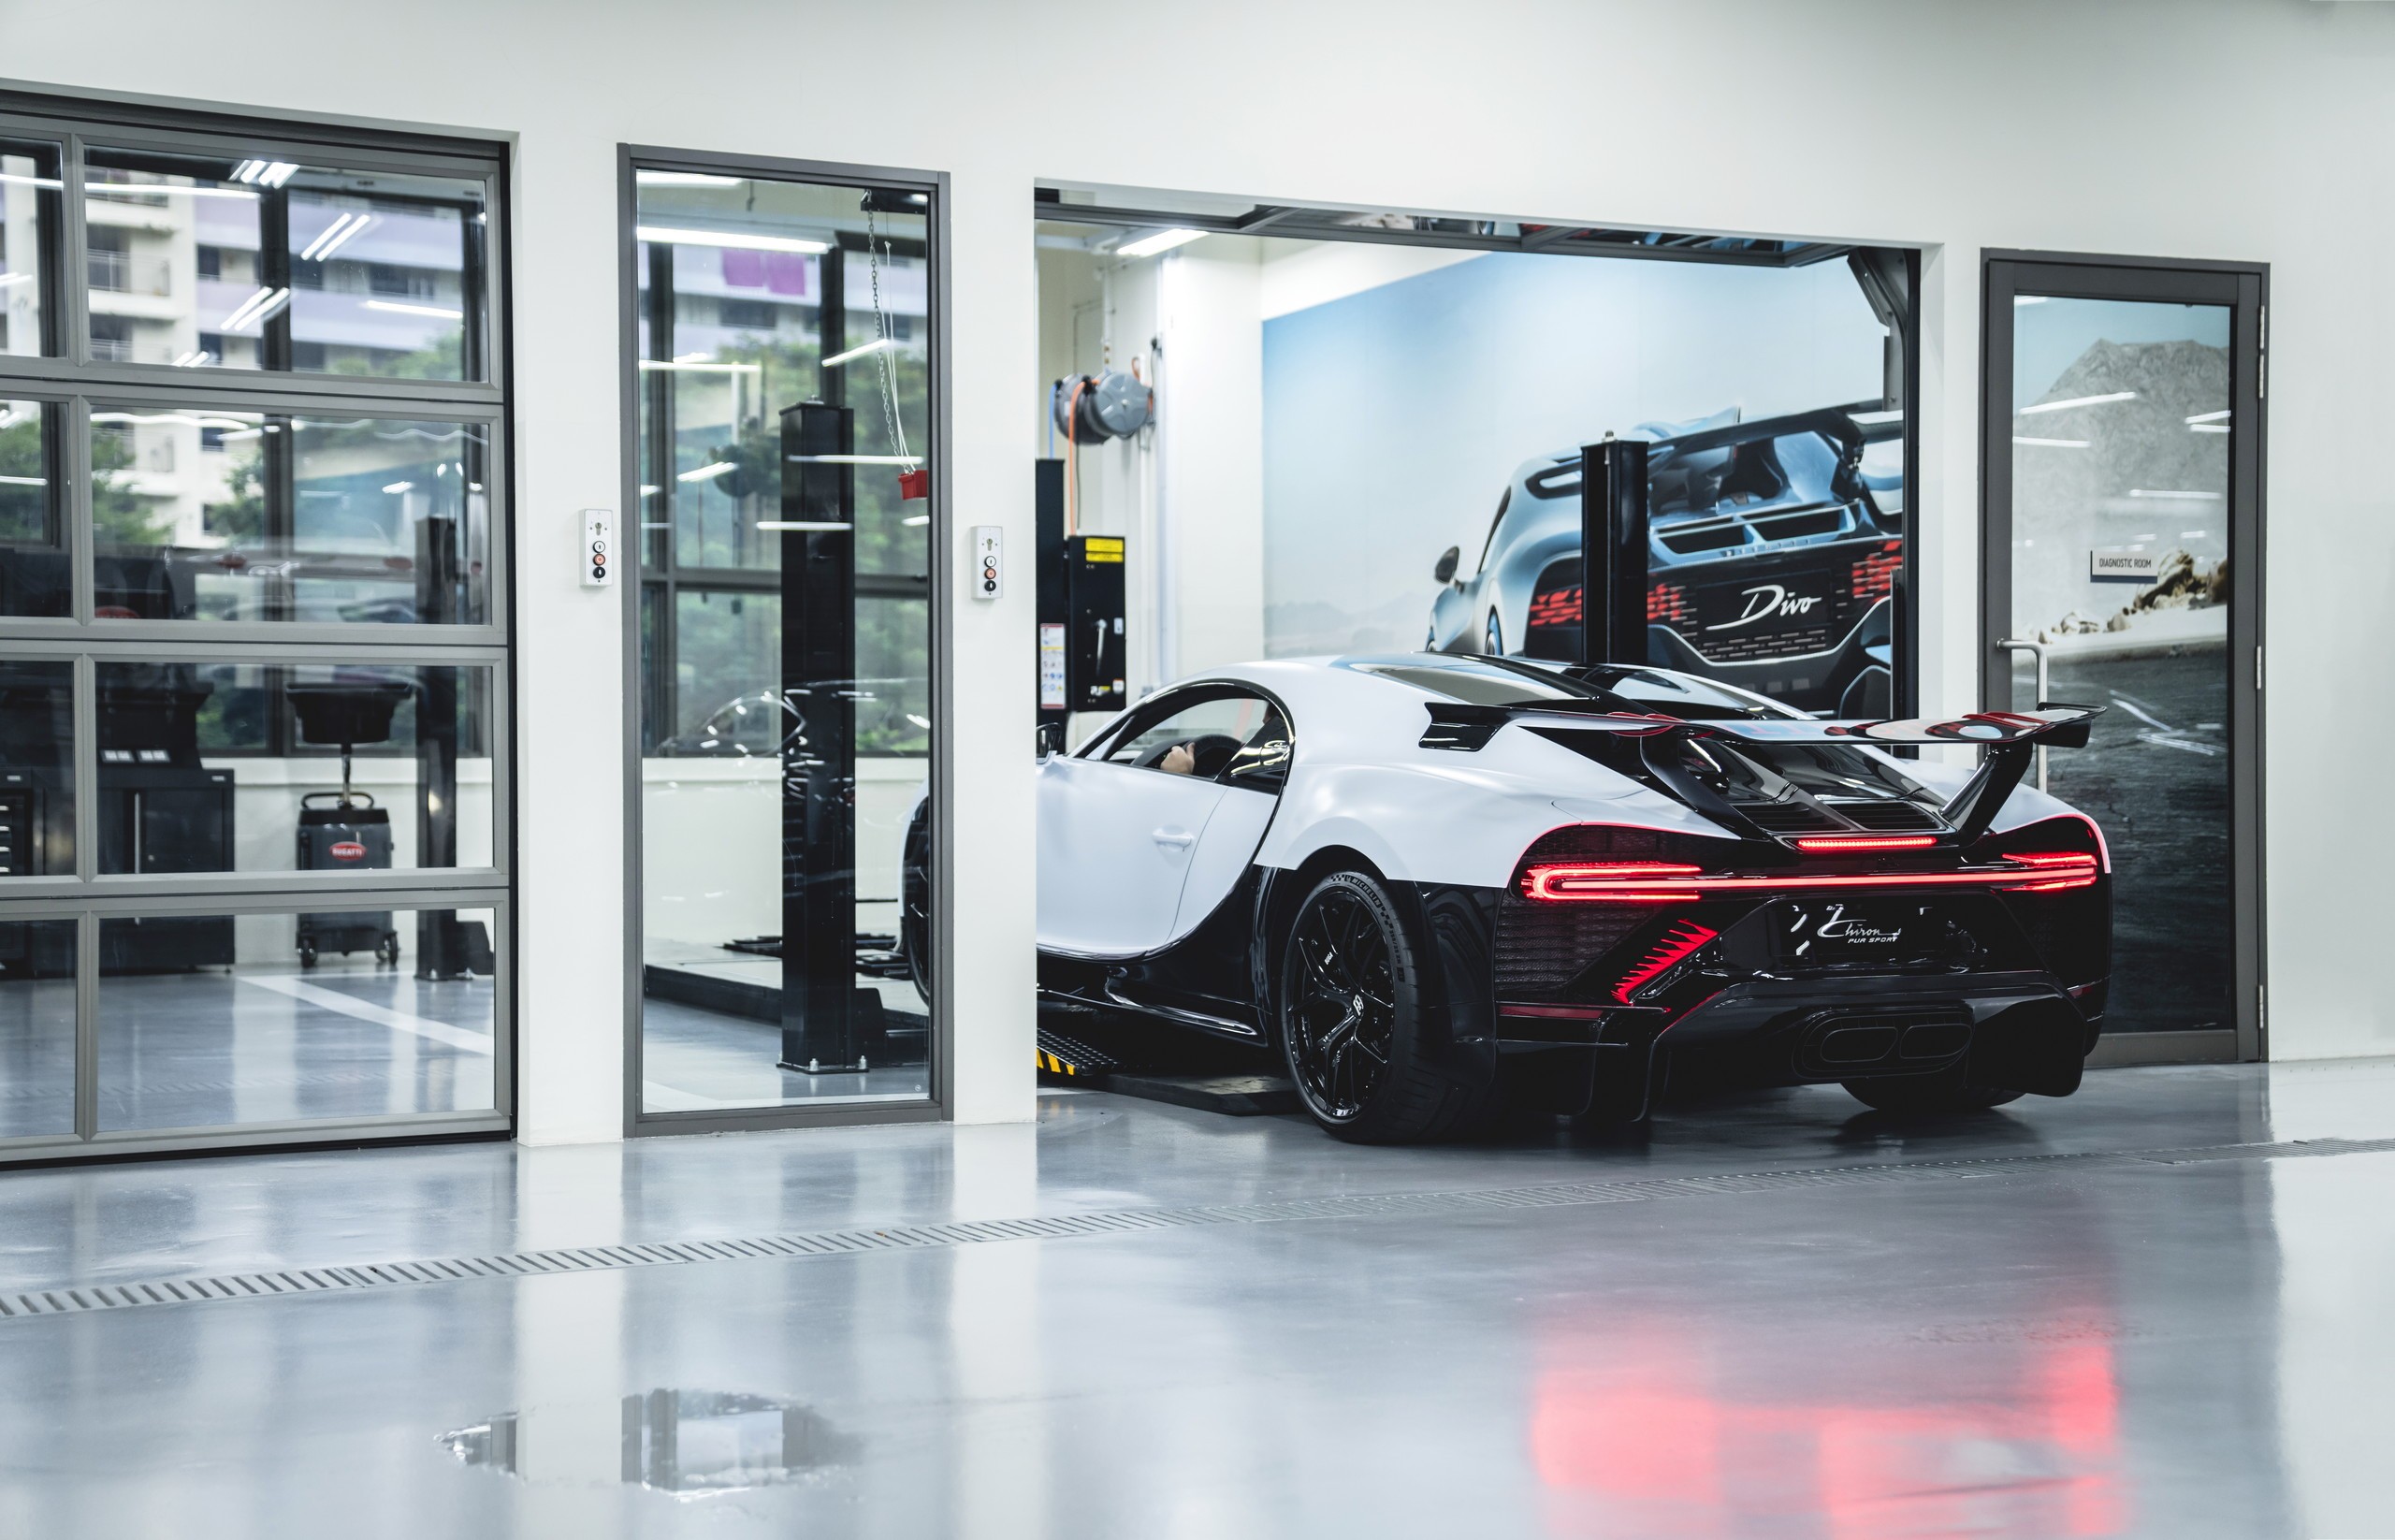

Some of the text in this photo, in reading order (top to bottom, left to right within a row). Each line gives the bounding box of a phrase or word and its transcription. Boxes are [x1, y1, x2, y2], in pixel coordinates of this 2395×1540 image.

[2098, 558, 2152, 568] DIAGNOSTIC ROOM
[1705, 584, 1822, 631] Divo
[1351, 878, 1382, 906] MICHELIN
[1817, 919, 1902, 937] Chiron
